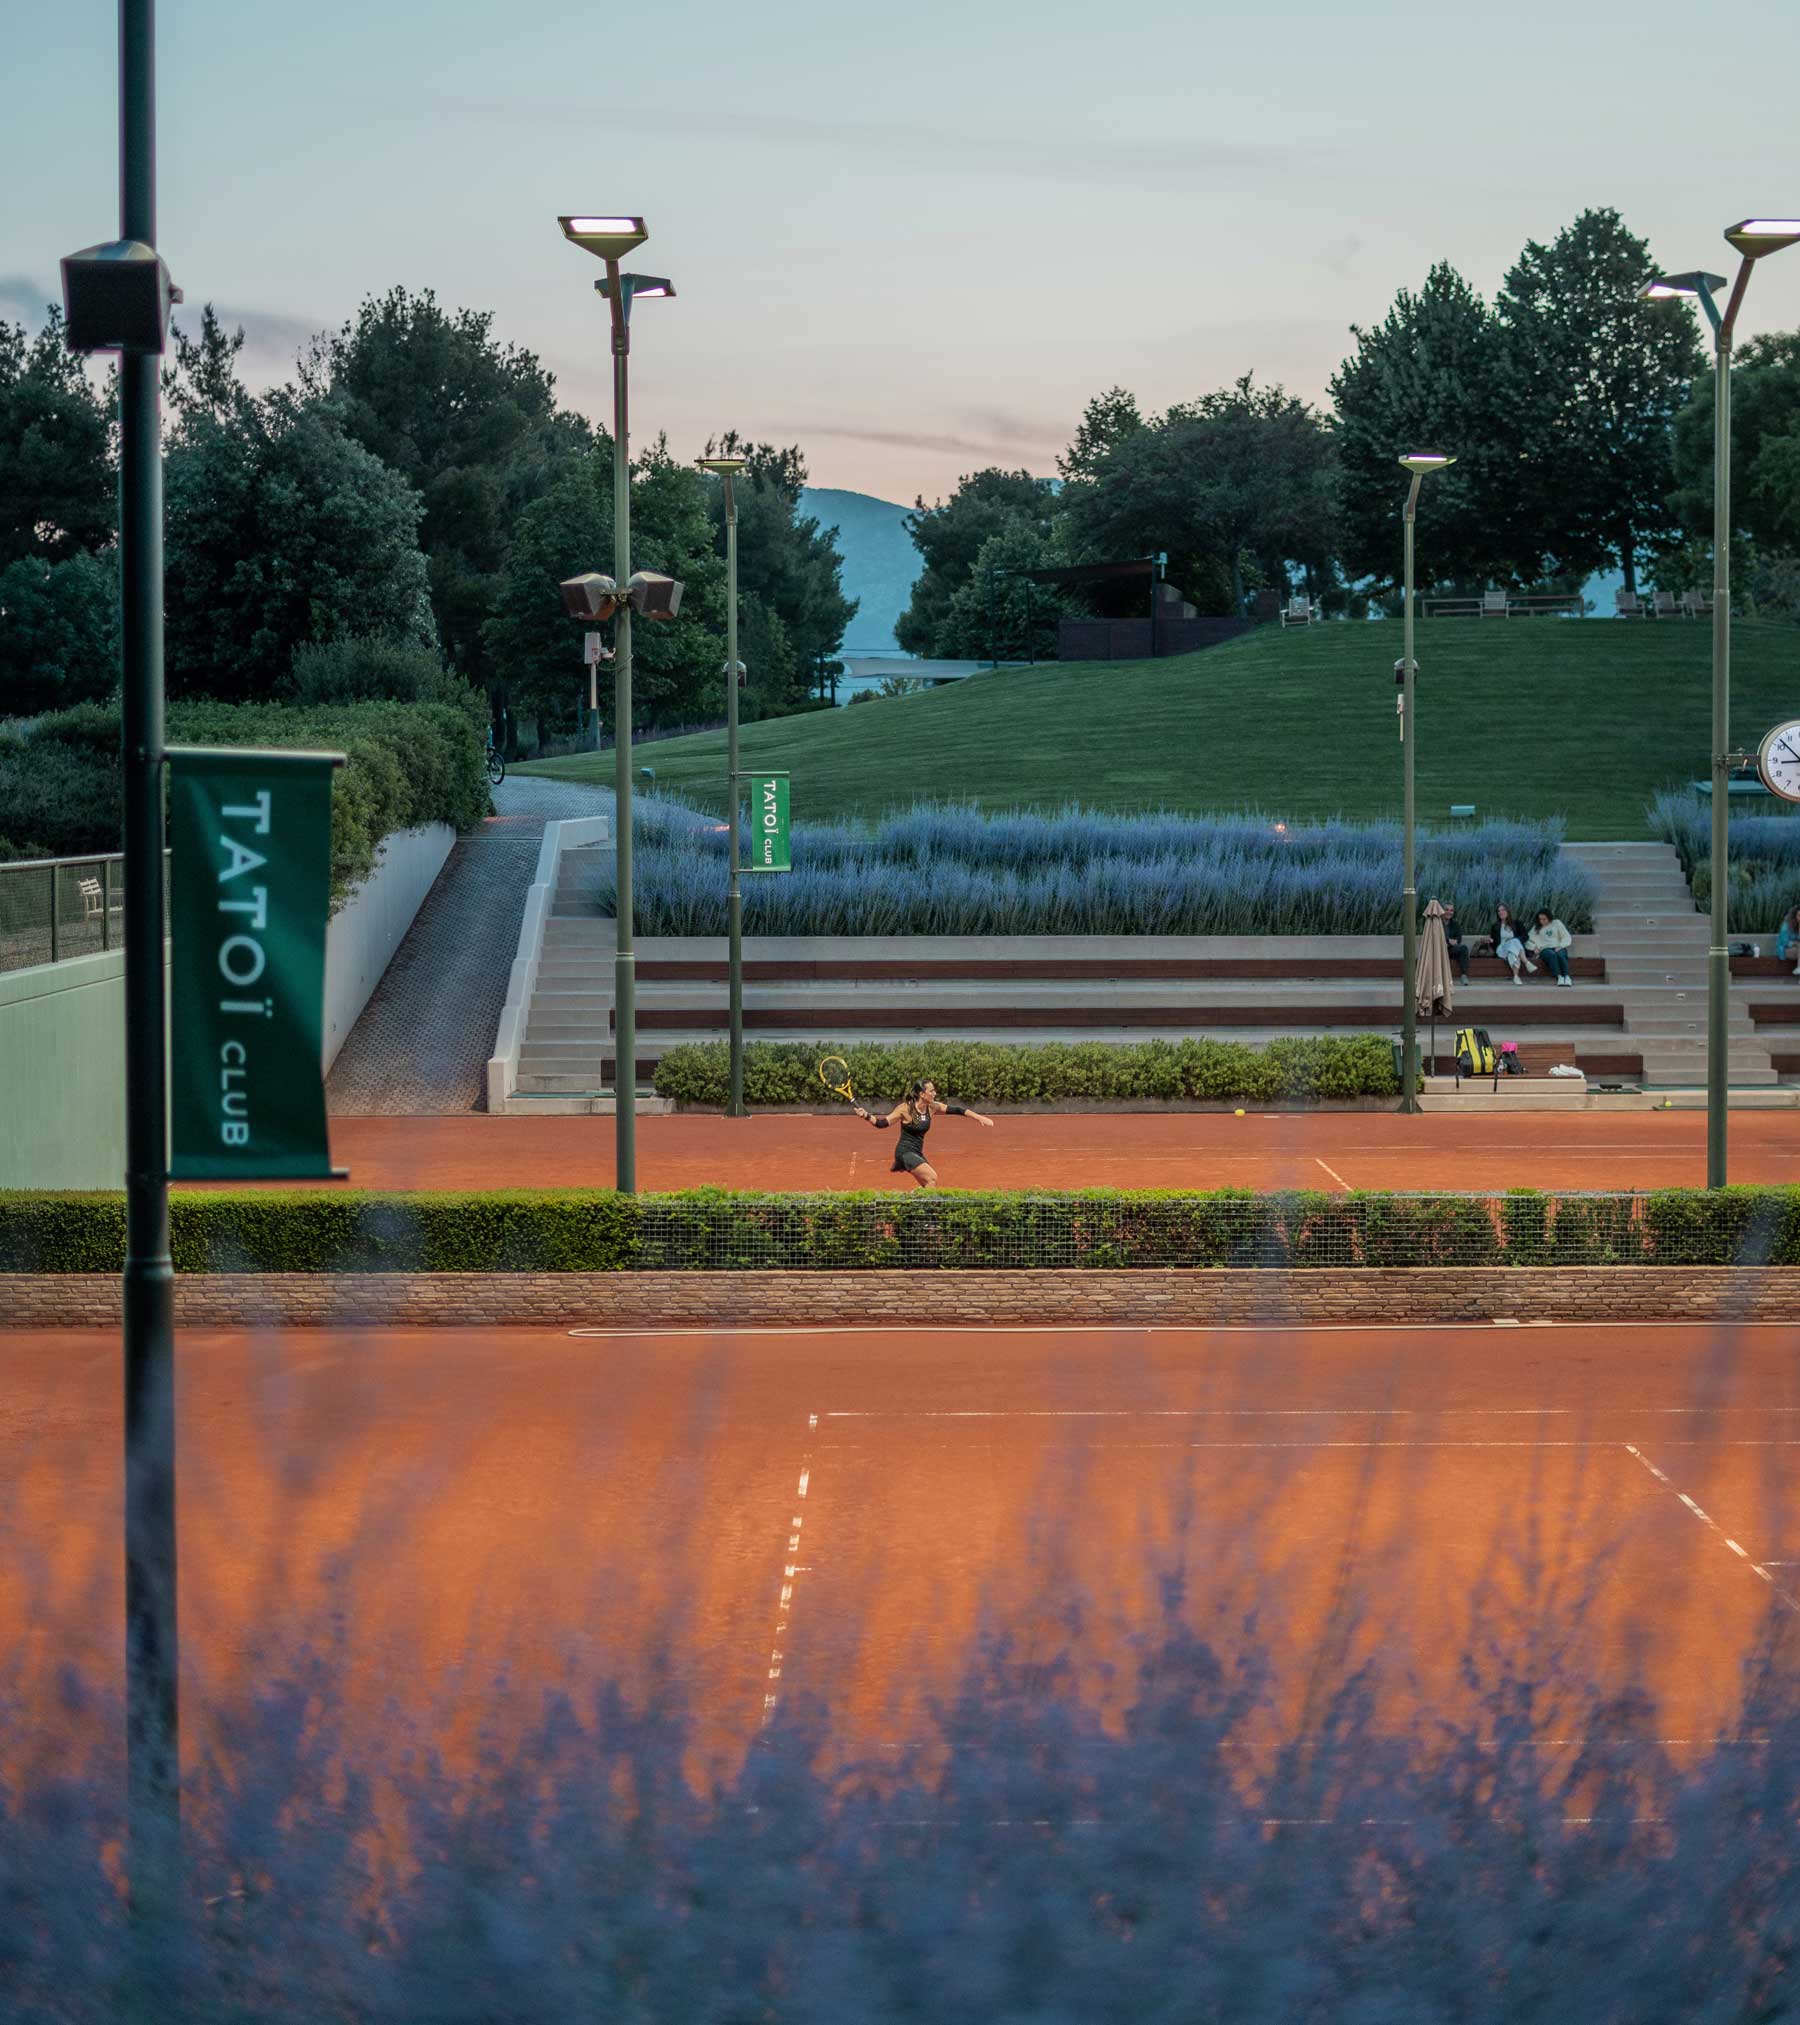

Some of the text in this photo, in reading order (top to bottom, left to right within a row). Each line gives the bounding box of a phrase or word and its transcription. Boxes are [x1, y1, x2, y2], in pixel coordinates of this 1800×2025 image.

[763, 780, 779, 865] TATOÏ CLUB
[218, 791, 273, 1147] TATOÏ CLUB
